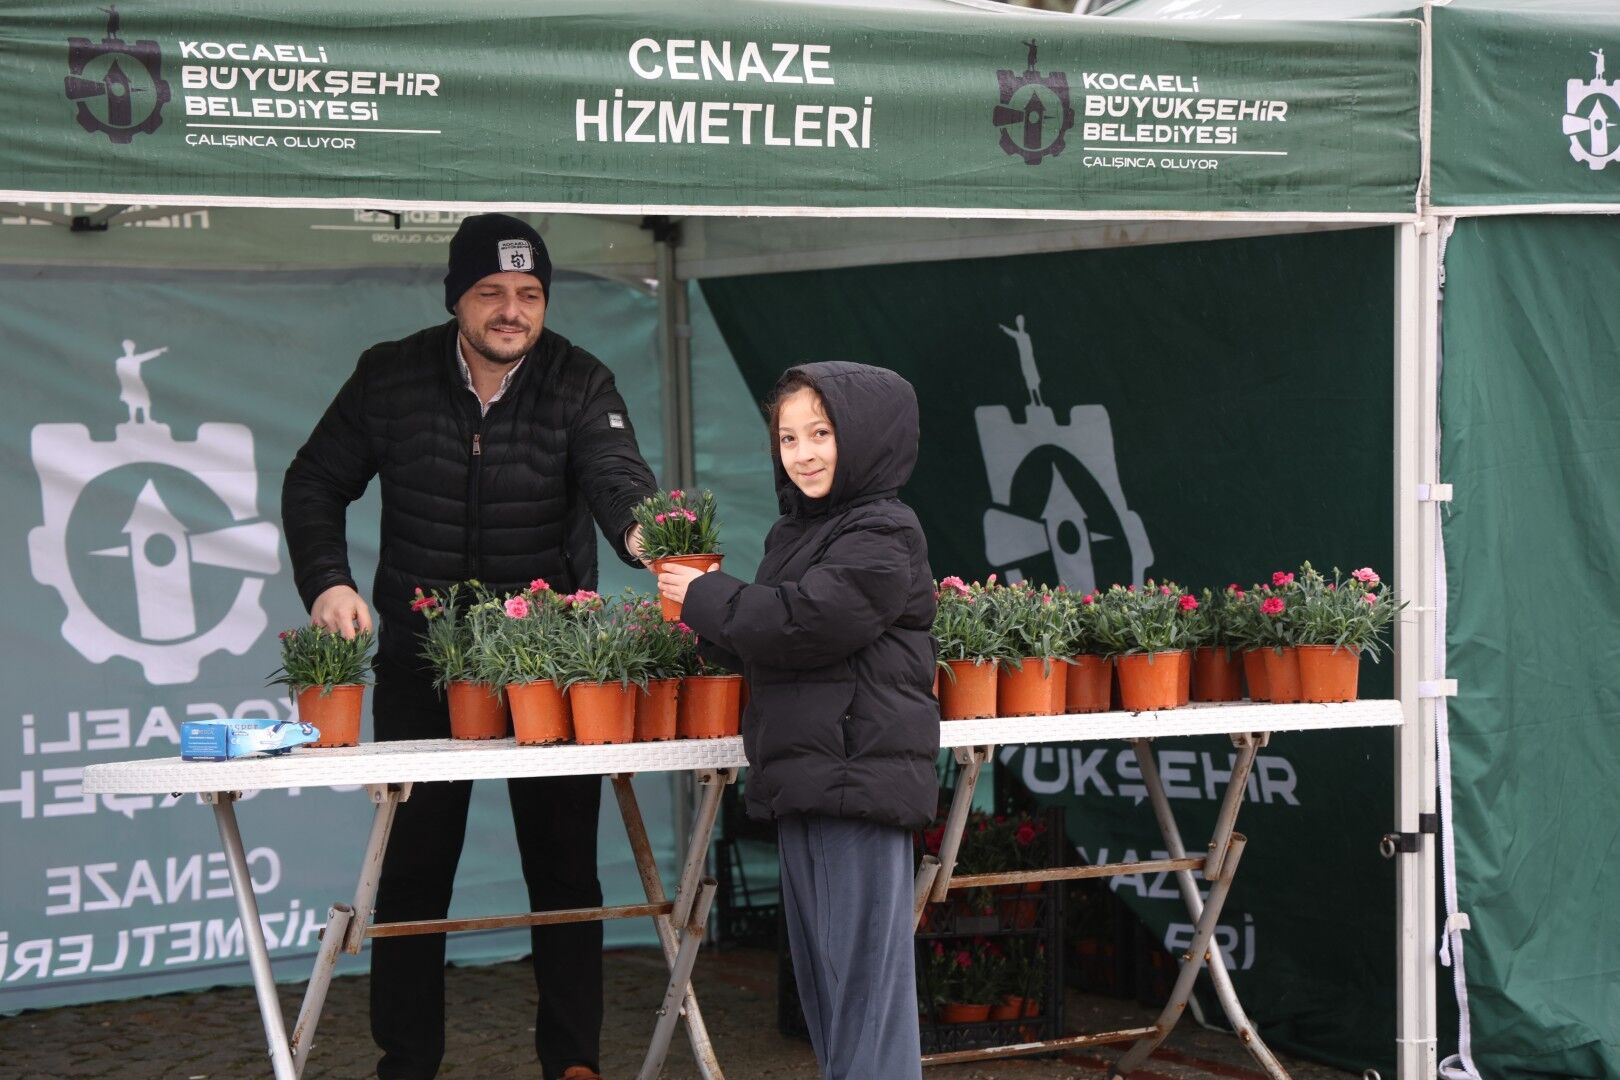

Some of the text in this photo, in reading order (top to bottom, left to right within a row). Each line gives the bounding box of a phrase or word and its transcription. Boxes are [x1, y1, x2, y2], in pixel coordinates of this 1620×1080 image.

[178, 41, 328, 63] KOCAELİ
[628, 37, 835, 85] CENAZE
[181, 65, 440, 98] BÜYÜKŞEHİR
[1082, 72, 1199, 93] KOCAELİ
[184, 96, 379, 121] BELEDİYESİ
[575, 88, 873, 149] HİZMETLERİ
[1084, 95, 1288, 123] BÜYÜKŞEHİR
[185, 133, 356, 150] ÇALIŞINCA OLUYOR
[1083, 122, 1238, 144] BELEDİYESİ
[1082, 156, 1219, 170] ÇALIŞINCA OLUYOR
